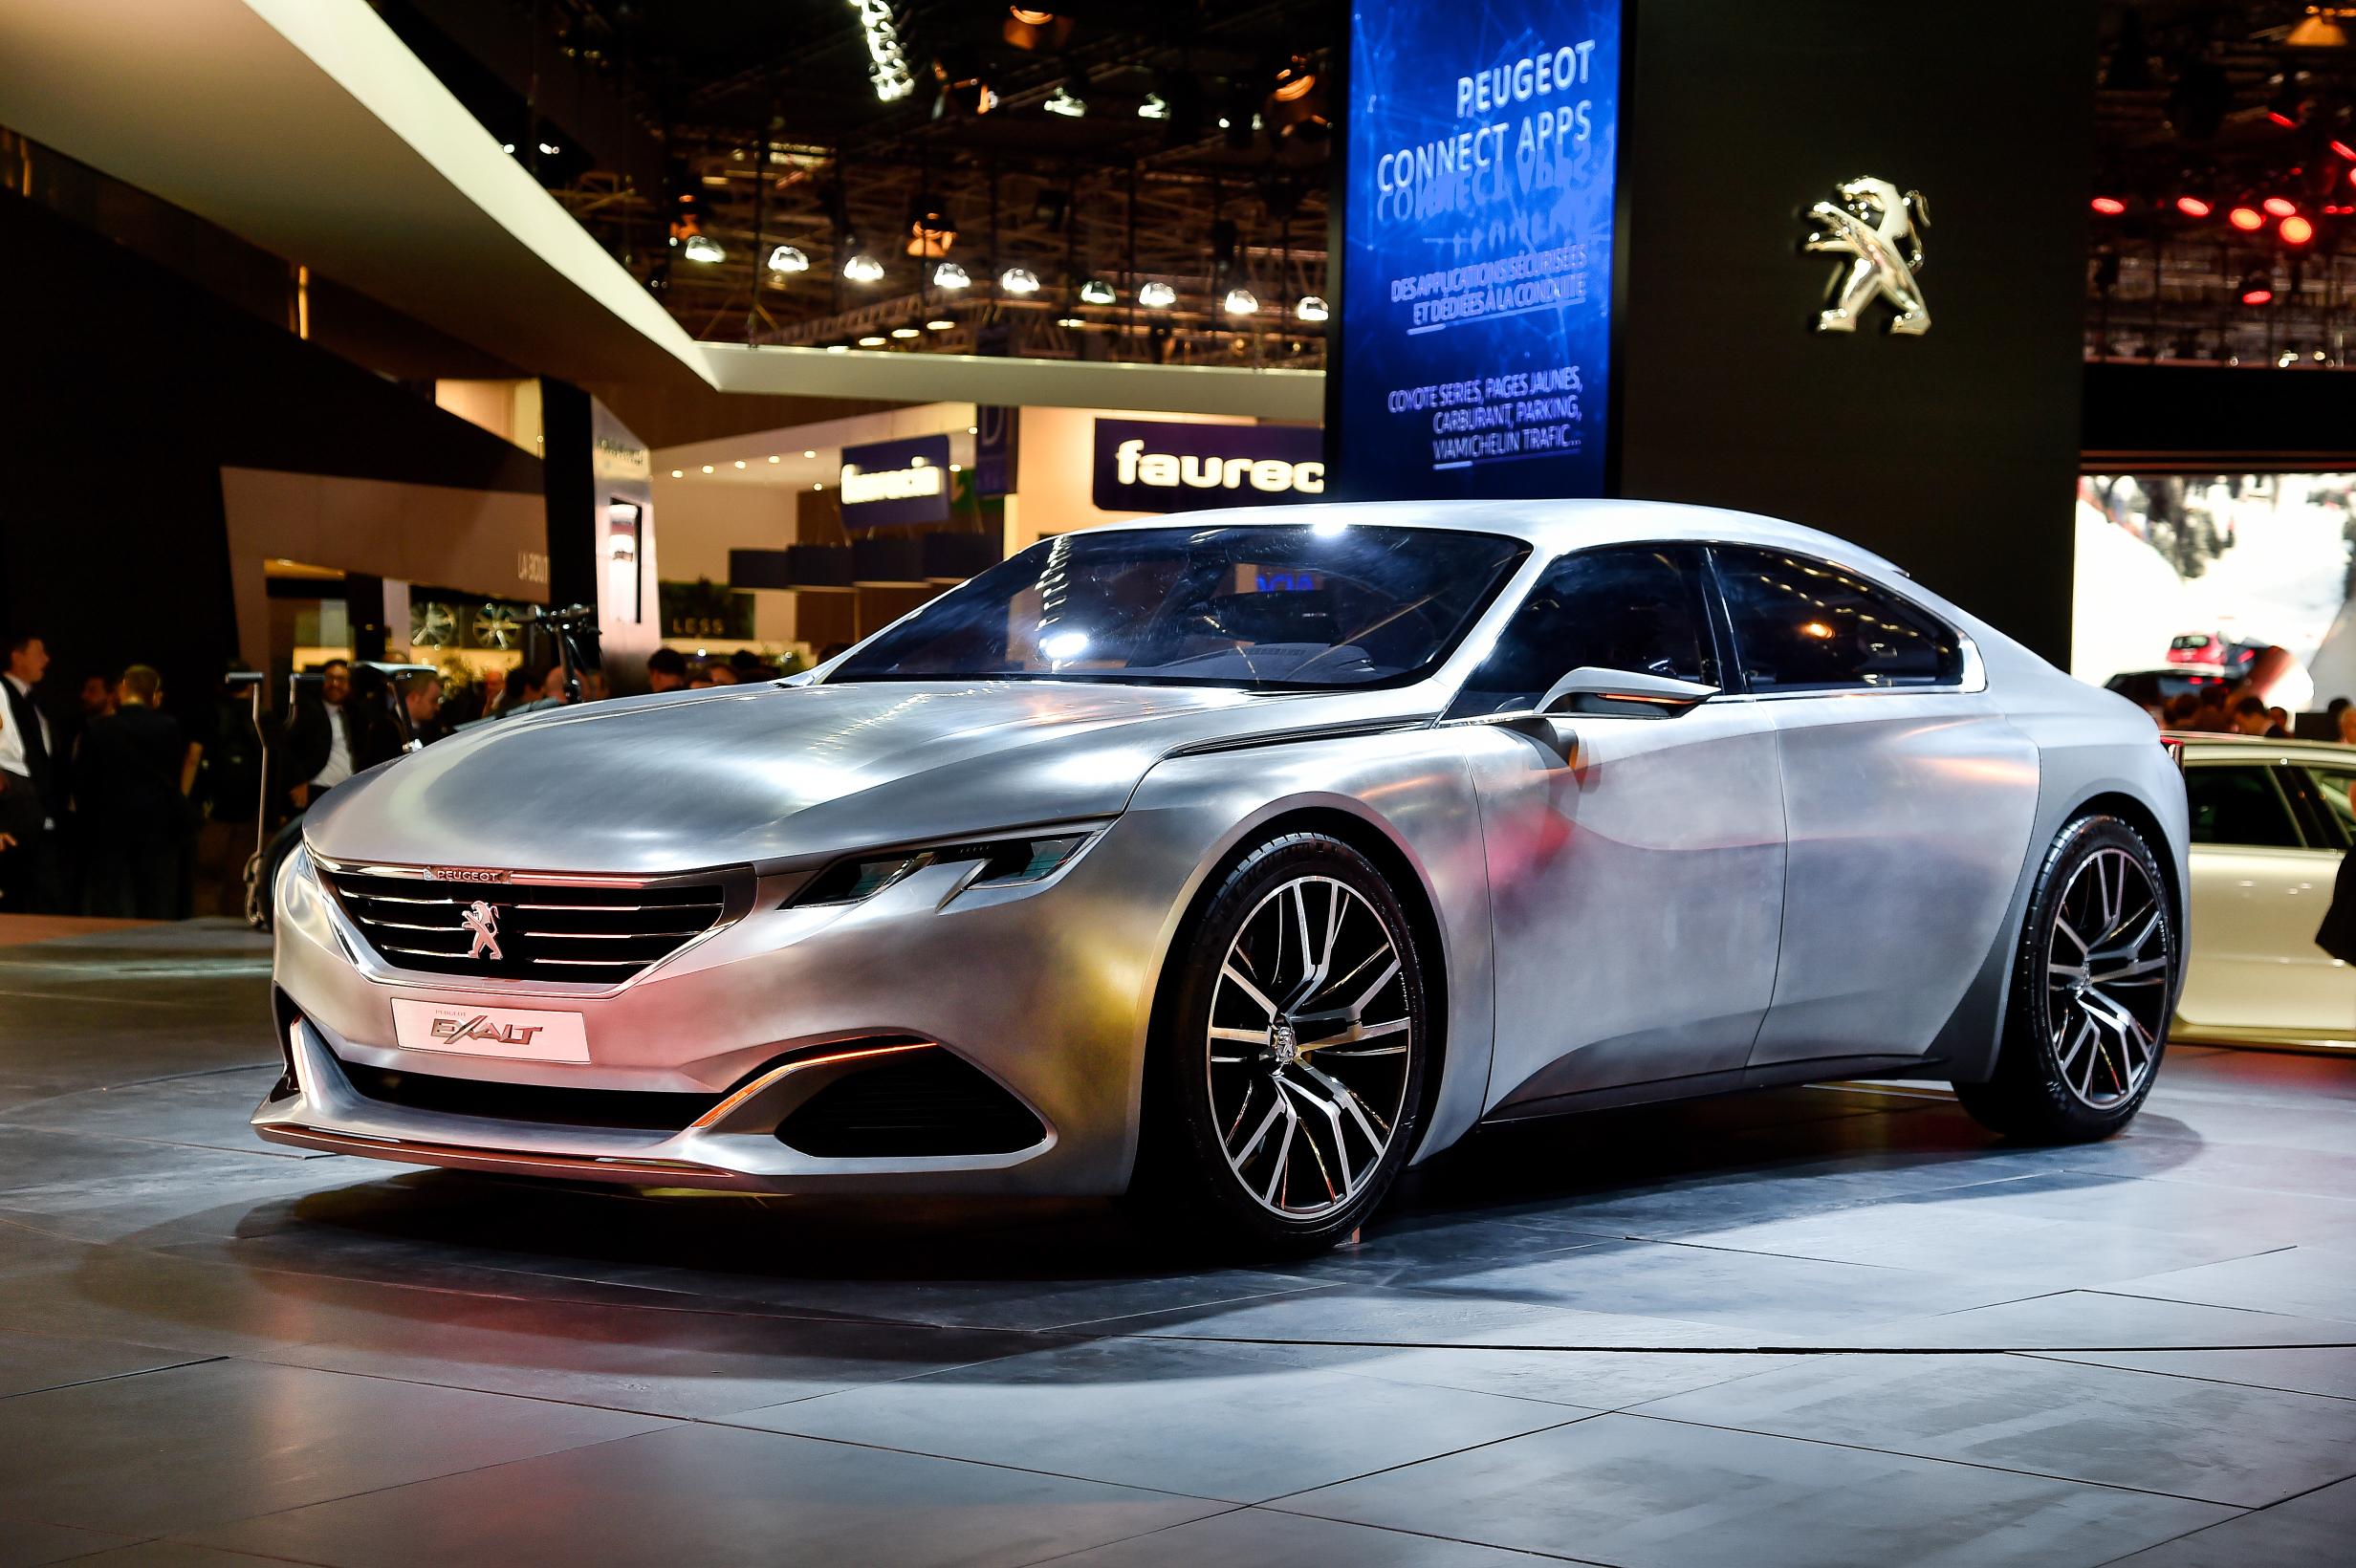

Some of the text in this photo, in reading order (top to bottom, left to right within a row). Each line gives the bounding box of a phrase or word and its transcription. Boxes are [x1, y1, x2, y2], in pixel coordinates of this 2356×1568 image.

[1456, 39, 1595, 118] PEUGEOT
[1377, 99, 1592, 192] CONNECT APPS
[1391, 276, 1417, 302] DES
[1416, 258, 1508, 297] APPLICATIONS
[1413, 300, 1429, 326] ET
[1387, 385, 1439, 413] COYOTE
[1485, 373, 1529, 399] PAGES
[437, 870, 498, 882] PEUGEOT
[430, 1014, 544, 1045] EXALT
